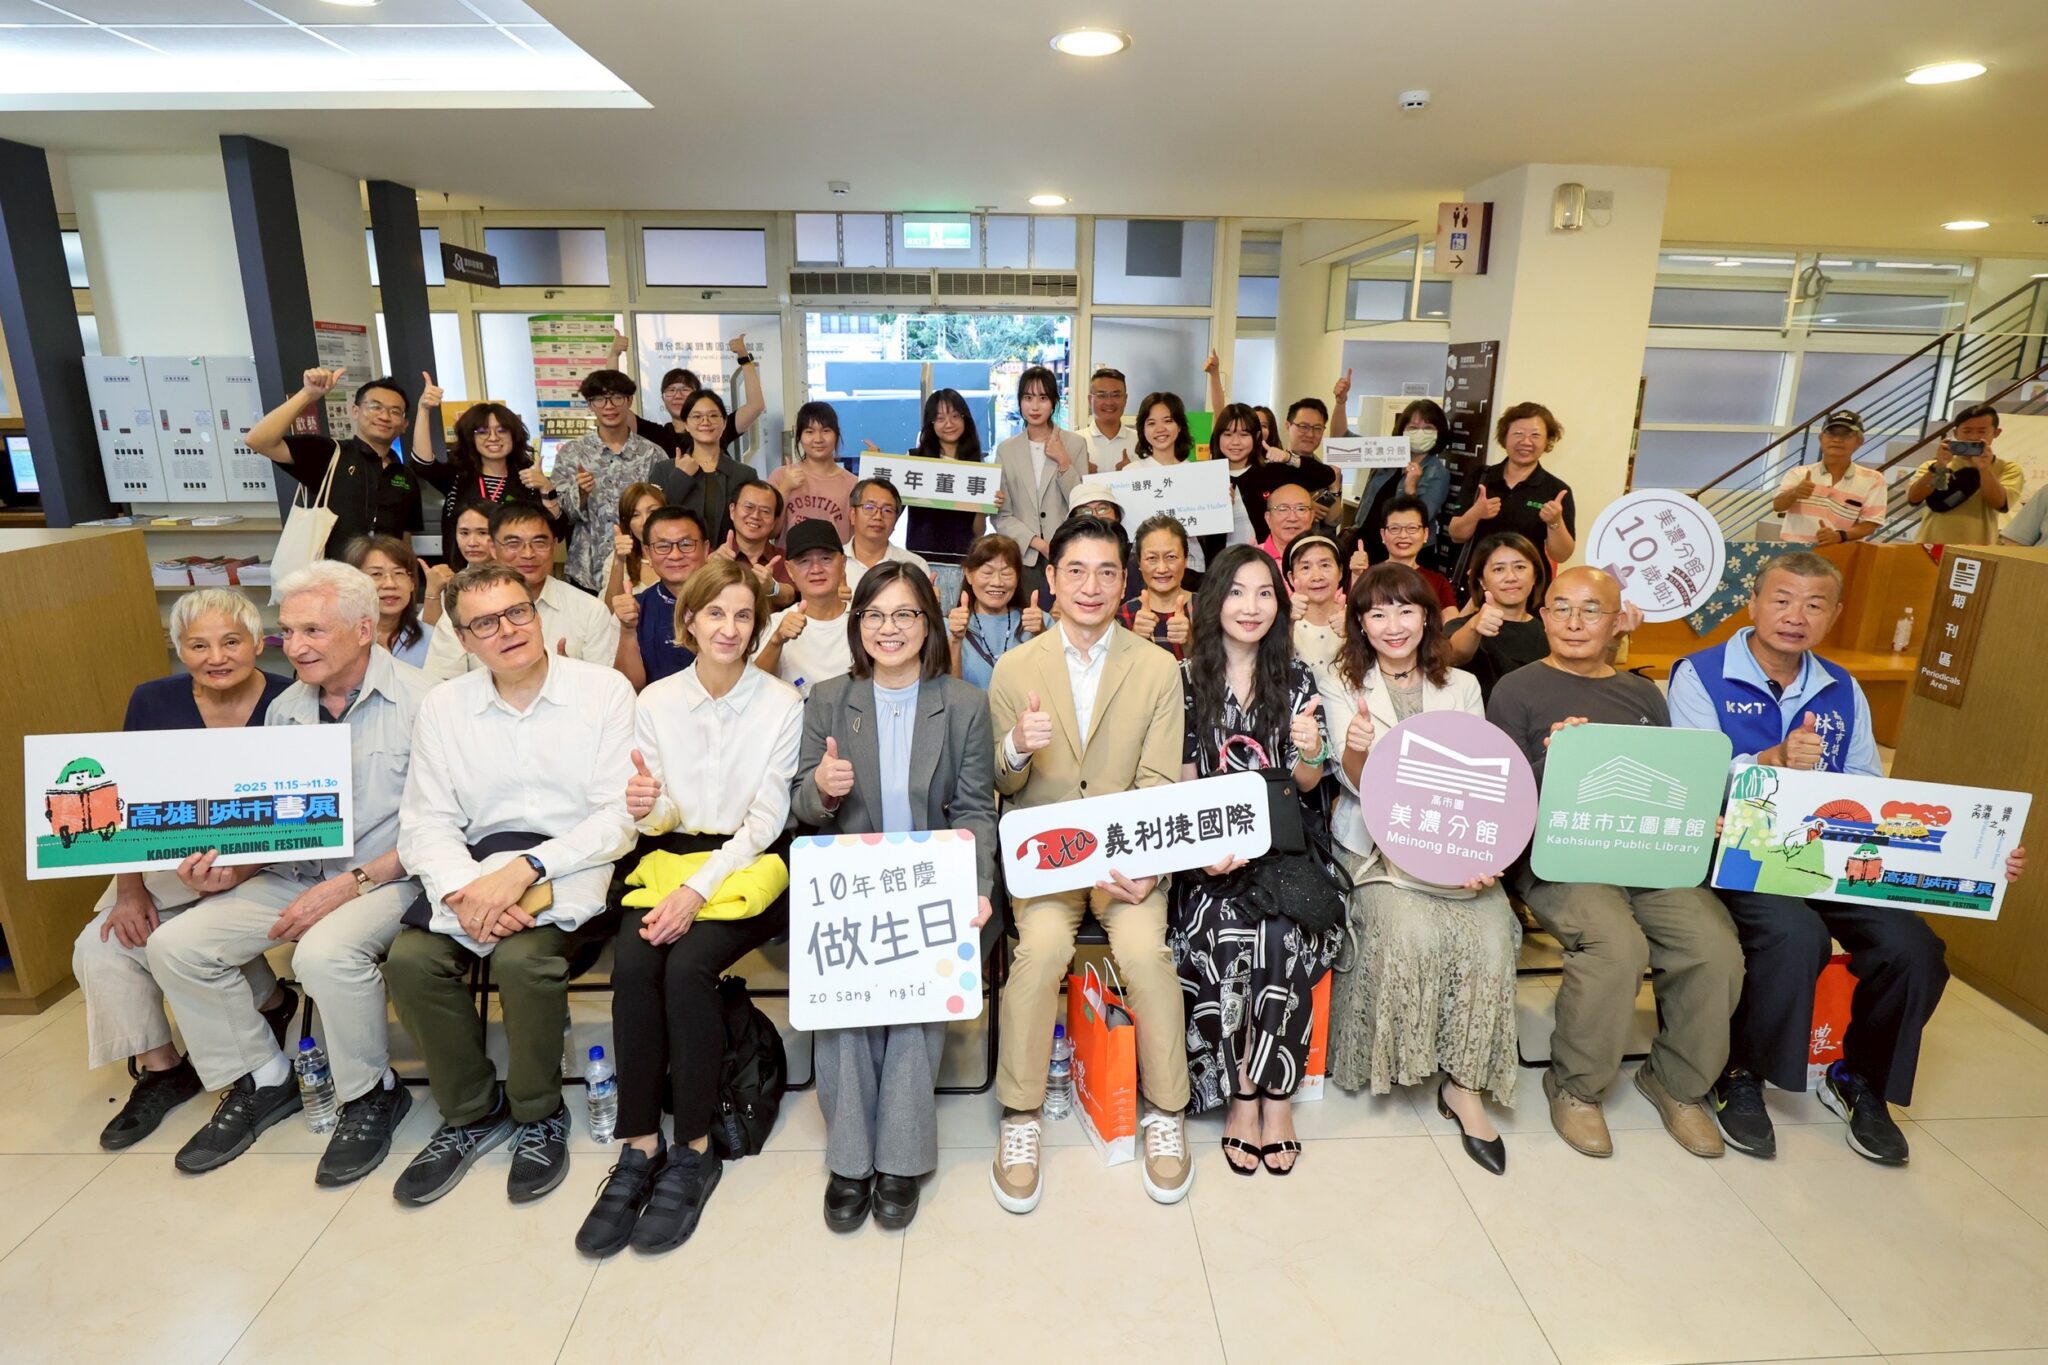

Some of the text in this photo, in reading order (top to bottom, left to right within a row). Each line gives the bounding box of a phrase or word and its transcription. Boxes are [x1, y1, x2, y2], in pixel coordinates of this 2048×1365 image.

[873, 466, 987, 495] 青年董事
[1654, 508, 1705, 577] 美濃分館
[1921, 666, 1961, 686] Periodicals
[1929, 680, 1948, 691] Area
[1725, 701, 1766, 715] KMT
[234, 782, 267, 793] 2025
[129, 795, 338, 827] 高雄 城市書展
[1430, 794, 1465, 811] 高市圖
[1104, 803, 1256, 858] 義利捷國際
[1388, 802, 1499, 846] 美濃分館
[1548, 810, 1707, 838] 高雄市立圖書館
[220, 840, 270, 855] READING
[274, 836, 324, 850] FESTIVAL
[1386, 831, 1494, 863] Meinong Branch
[1546, 834, 1700, 855] Kaohsiung Public Library
[809, 861, 937, 907] 10年館慶
[807, 899, 957, 976] 做生日
[809, 992, 827, 1003] zo
